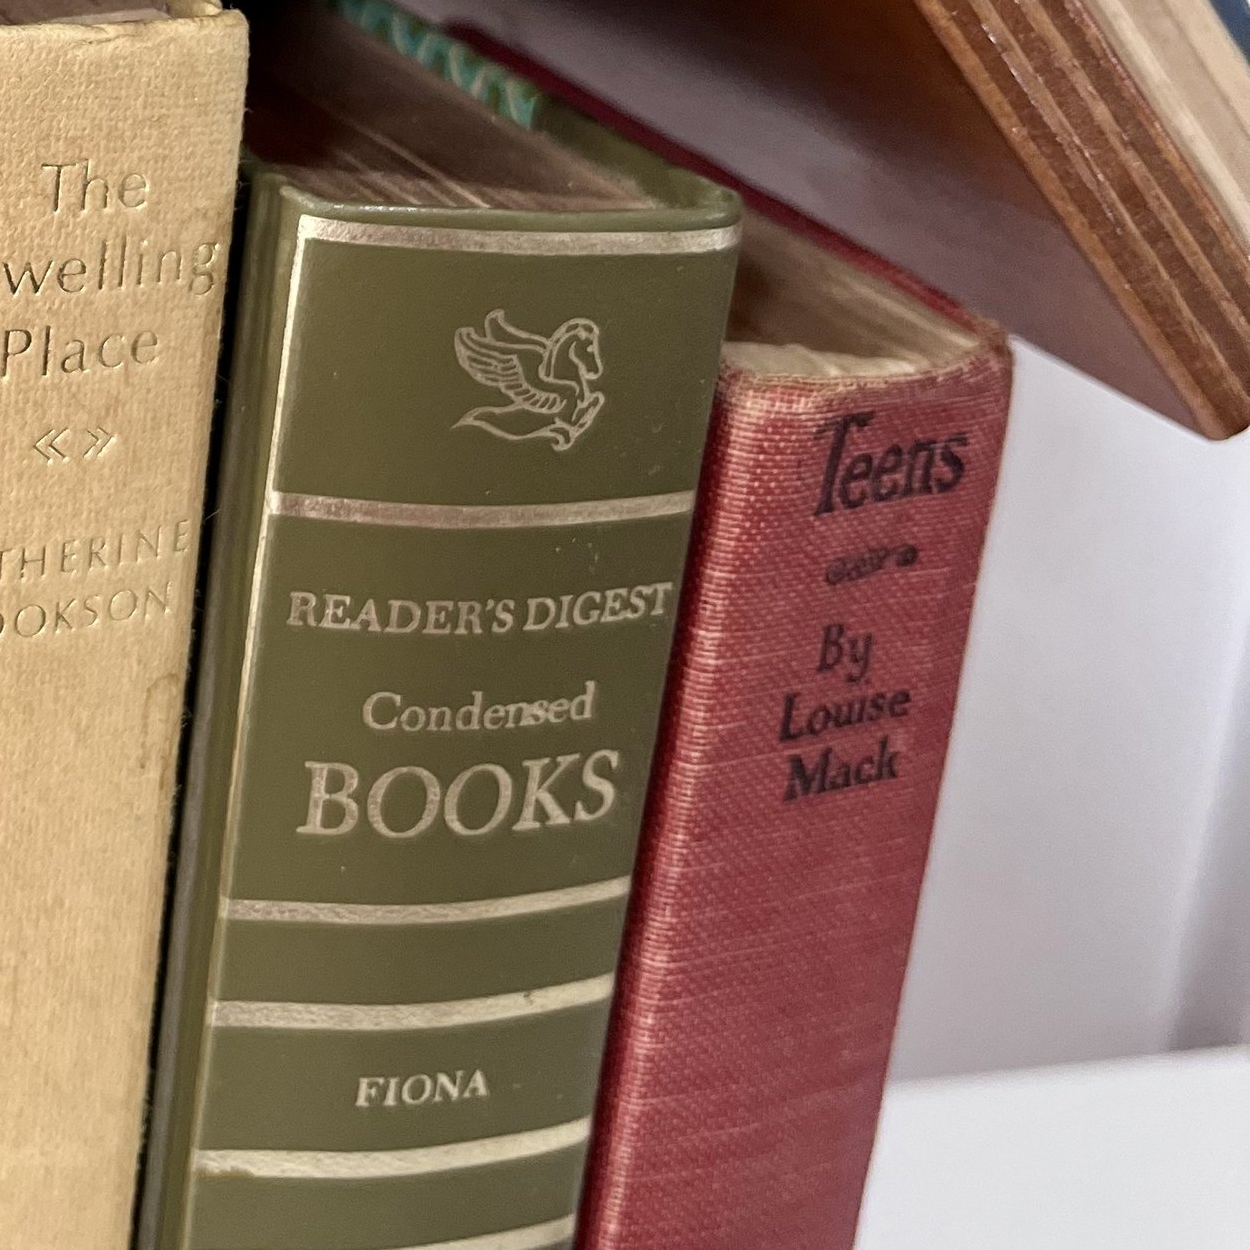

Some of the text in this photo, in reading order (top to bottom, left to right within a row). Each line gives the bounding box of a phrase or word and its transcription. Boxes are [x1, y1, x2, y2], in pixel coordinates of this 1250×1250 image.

[41, 158, 149, 213] The
[1, 325, 158, 379] Place
[813, 410, 969, 517] Teens
[286, 581, 673, 635] READER'S DIGEST
[816, 622, 874, 683] By
[362, 680, 597, 731] Condensed
[778, 687, 912, 742] Louise
[296, 749, 621, 838] BOOKS
[783, 734, 899, 802] Mack
[354, 1069, 490, 1108] FIONA
